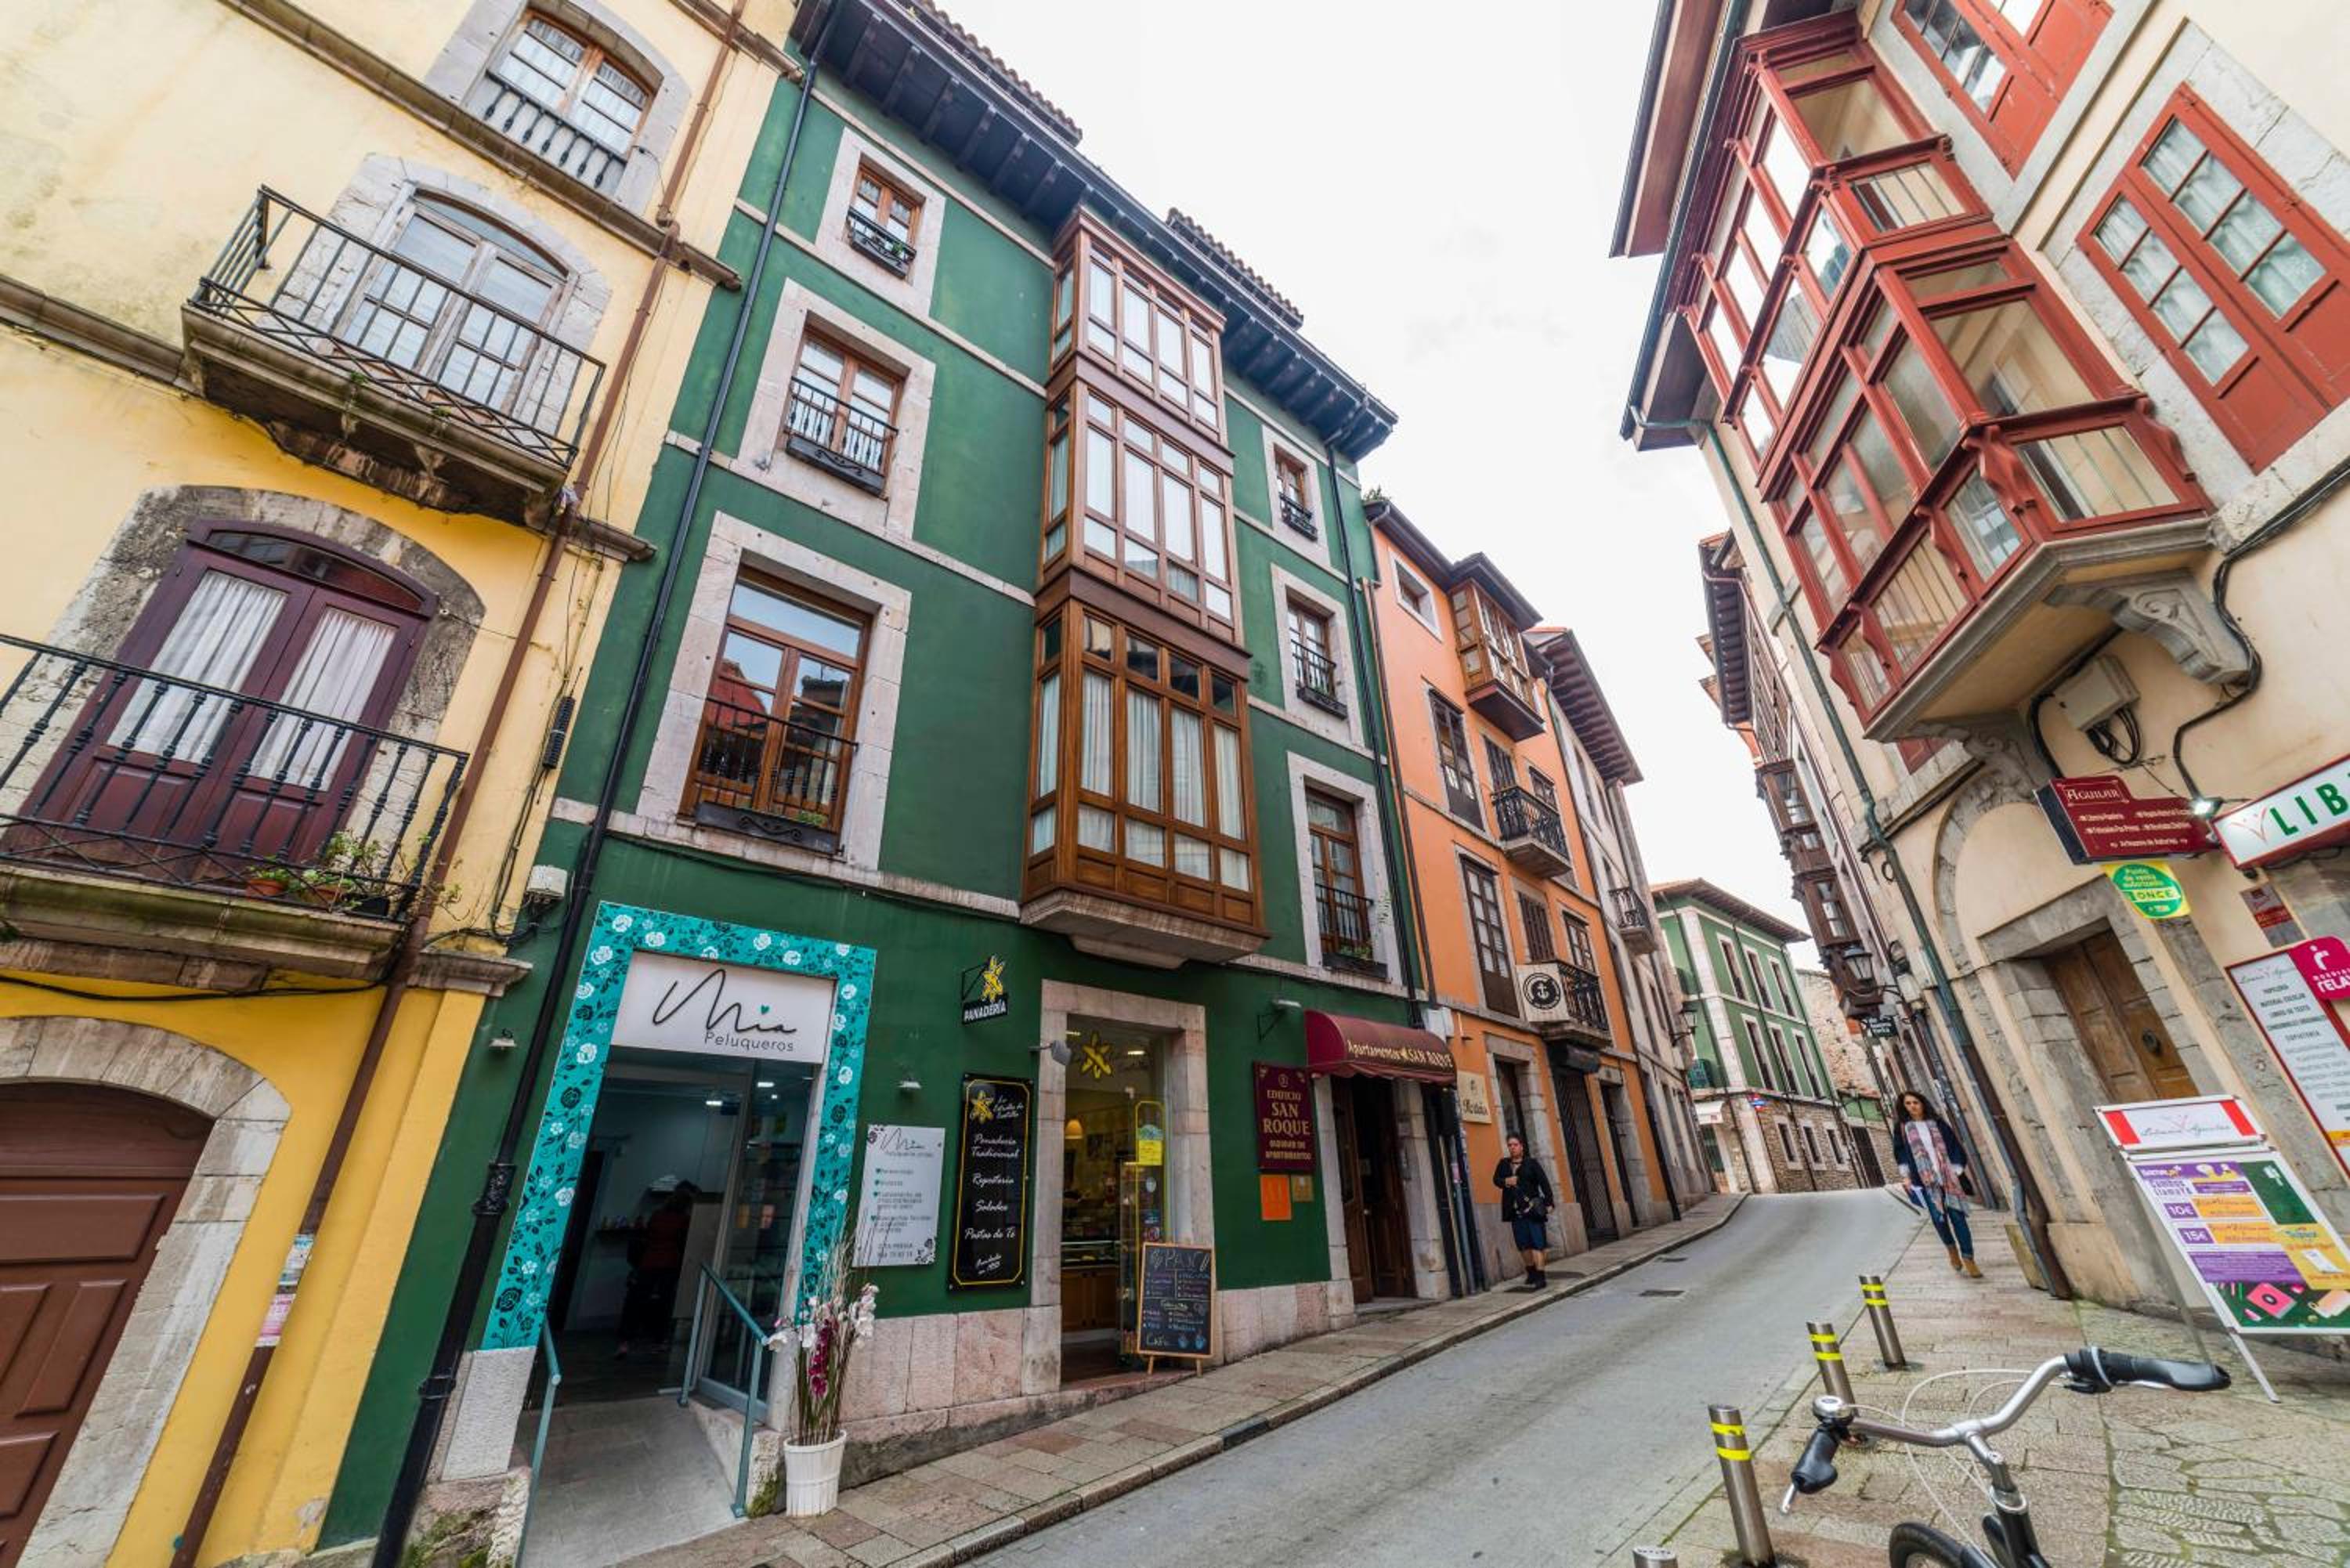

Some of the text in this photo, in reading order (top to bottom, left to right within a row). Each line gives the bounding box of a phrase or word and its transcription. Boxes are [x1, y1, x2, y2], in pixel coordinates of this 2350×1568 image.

[2270, 772, 2350, 836] LIB
[2136, 889, 2174, 900] ONCE
[653, 969, 797, 1033] Mia
[964, 999, 1007, 1021] PANADERÍA
[705, 1031, 794, 1052] Peluqueros
[1267, 1089, 1301, 1100] EDIFICIO
[1271, 1102, 1299, 1118] SAN
[1263, 1118, 1311, 1137] ROQUE
[971, 1145, 1020, 1158] Tradicional
[2168, 1205, 2194, 1216] 10€
[964, 1227, 992, 1241] Pastas
[992, 1228, 1003, 1239] de
[2183, 1230, 2208, 1241] 15€
